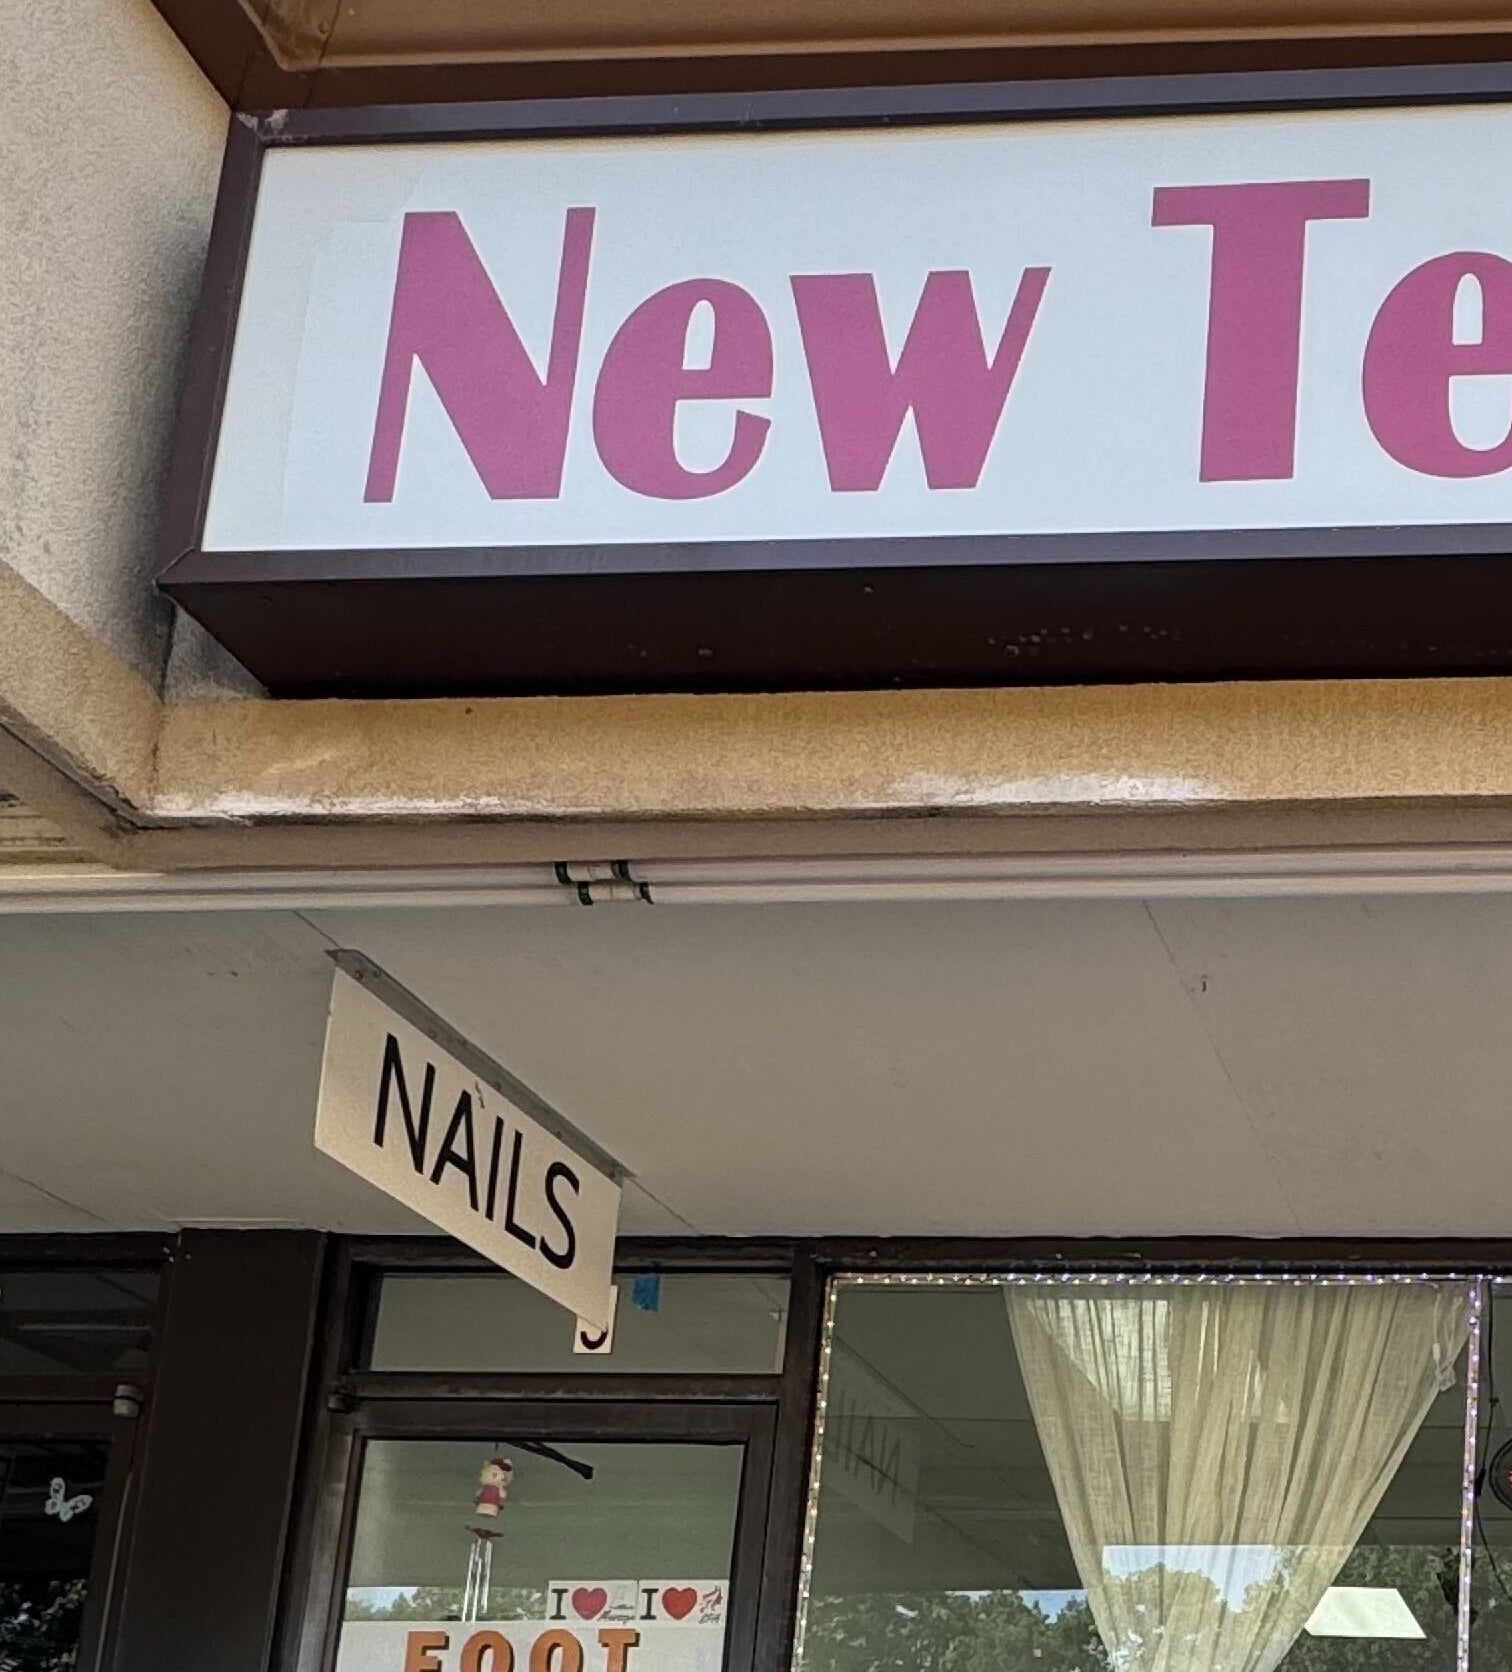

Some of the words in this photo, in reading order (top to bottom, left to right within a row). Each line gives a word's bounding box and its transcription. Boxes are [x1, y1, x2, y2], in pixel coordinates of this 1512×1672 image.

[364, 206, 1051, 503] New
[373, 1032, 580, 1270] NAILS
[549, 1587, 570, 1620] I
[638, 1587, 660, 1620] I
[404, 1629, 641, 1672] FOOT
